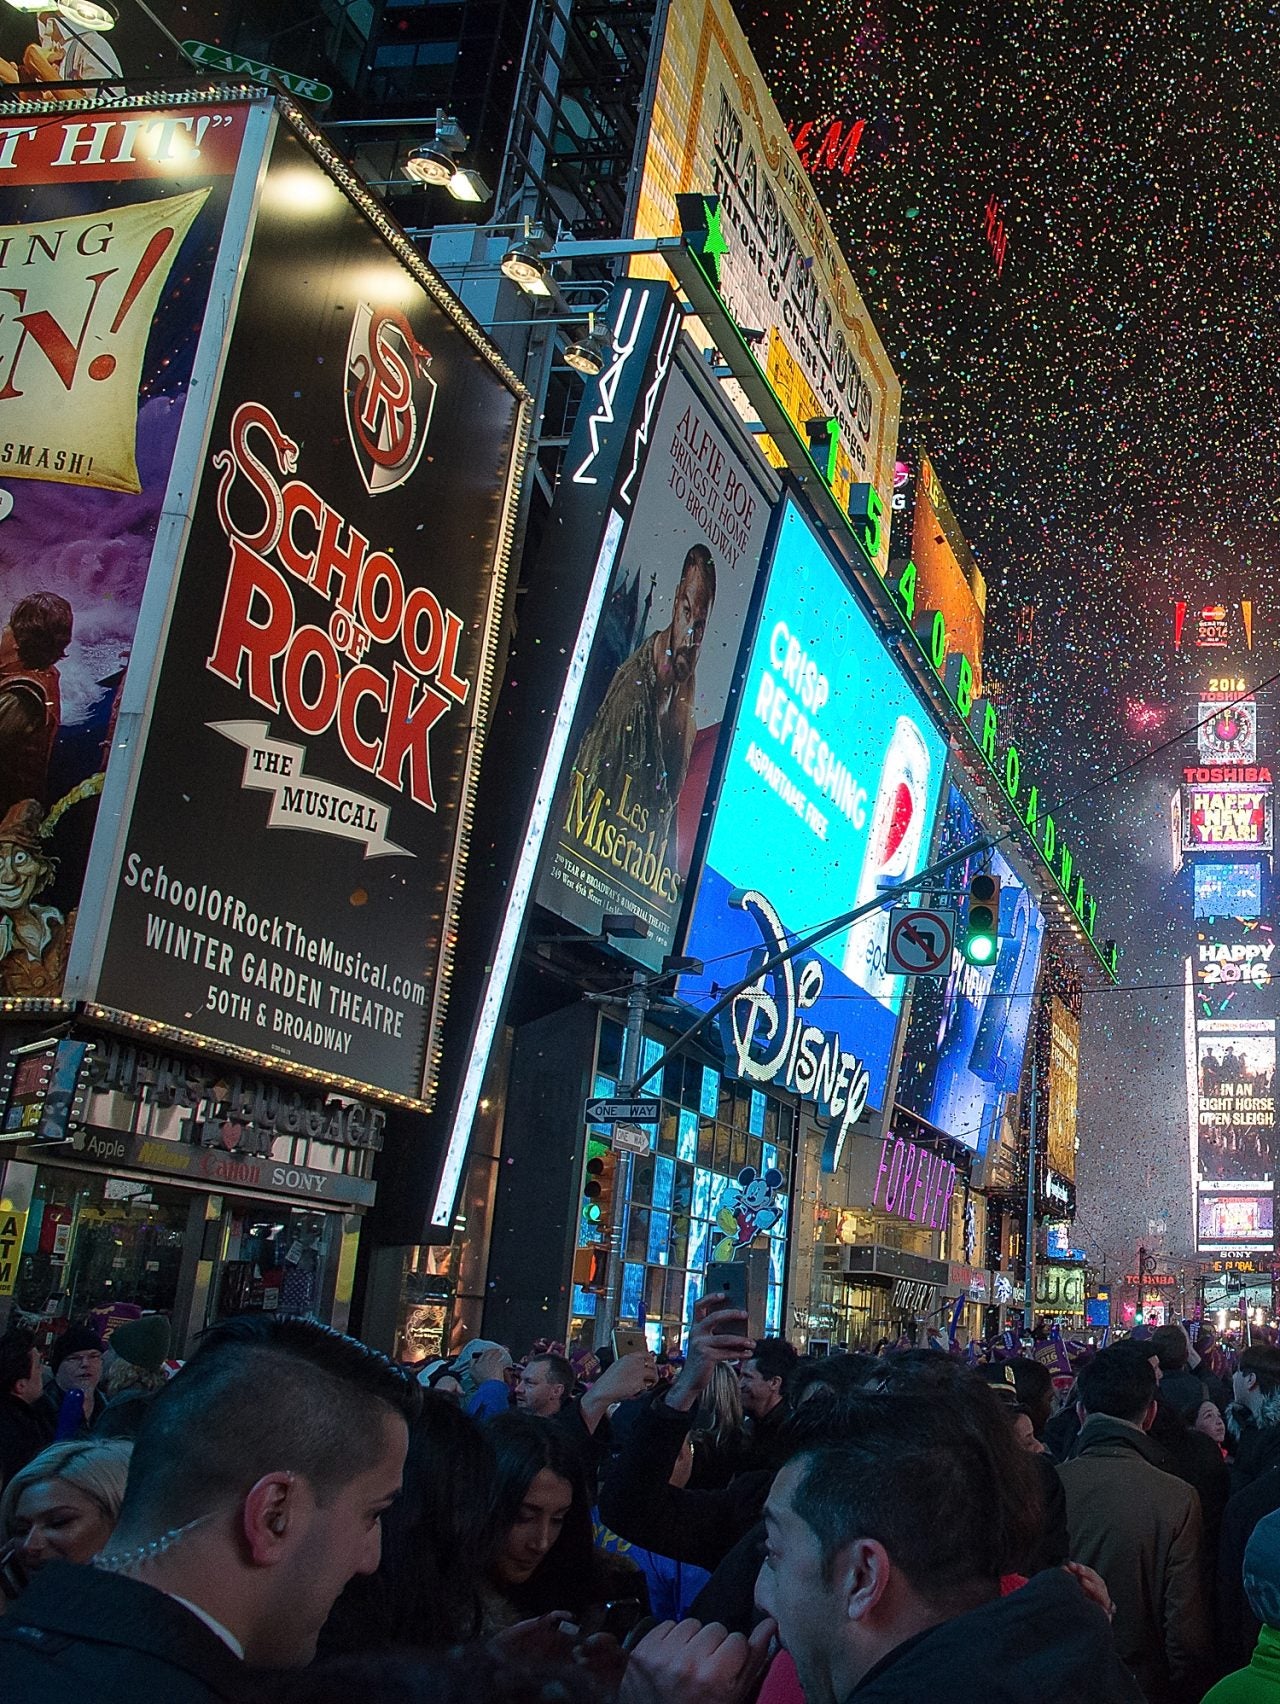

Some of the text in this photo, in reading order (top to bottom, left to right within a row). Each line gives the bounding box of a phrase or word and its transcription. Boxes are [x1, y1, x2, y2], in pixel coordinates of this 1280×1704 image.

[192, 43, 320, 100] LAMAR
[713, 158, 766, 276] Throat
[783, 298, 819, 379] Chest
[820, 366, 868, 473] Lozenges
[1, 442, 95, 476] SMASH!
[676, 405, 758, 531] ALFIE BOE
[669, 432, 750, 555] BRINGS IT HOME
[667, 463, 741, 571] TO BROADWAY
[329, 610, 371, 664] OF
[206, 533, 452, 813] ROCK
[769, 620, 830, 716] CRISP
[1208, 678, 1247, 693] 2016
[1199, 692, 1256, 702] TOSHIBA
[251, 749, 294, 778] THE
[754, 670, 868, 832] REFRESHING
[744, 740, 830, 843] ASPARTAME FREE
[958, 653, 1098, 937] BROADWAY
[1183, 767, 1273, 783] TOSHIBA
[280, 786, 379, 834] MUSICAL
[616, 773, 651, 833] Les
[1193, 793, 1265, 810] HAPPY
[1204, 809, 1254, 826] NEW
[562, 769, 685, 905] Misérables
[124, 852, 427, 1006] SchoolOfRockTheMusical.com
[1200, 944, 1276, 963] HAPPY
[1203, 963, 1269, 985] 2016
[146, 912, 405, 1039] WINTER GARDEN THEATRE
[206, 984, 353, 1055] 50TH & BROADWAY
[1199, 1097, 1275, 1111] EIGHT HORSE
[1220, 1083, 1253, 1096] IN AN
[595, 1105, 655, 1118] ONE WAY
[1199, 1112, 1232, 1126] OPEN
[87, 1136, 126, 1159] Apple
[616, 1130, 646, 1147] ONE WAY
[199, 1154, 262, 1185] Canon
[271, 1167, 329, 1193] SONY
[873, 1131, 957, 1233] FOREVER
[1220, 1251, 1252, 1259] SONY
